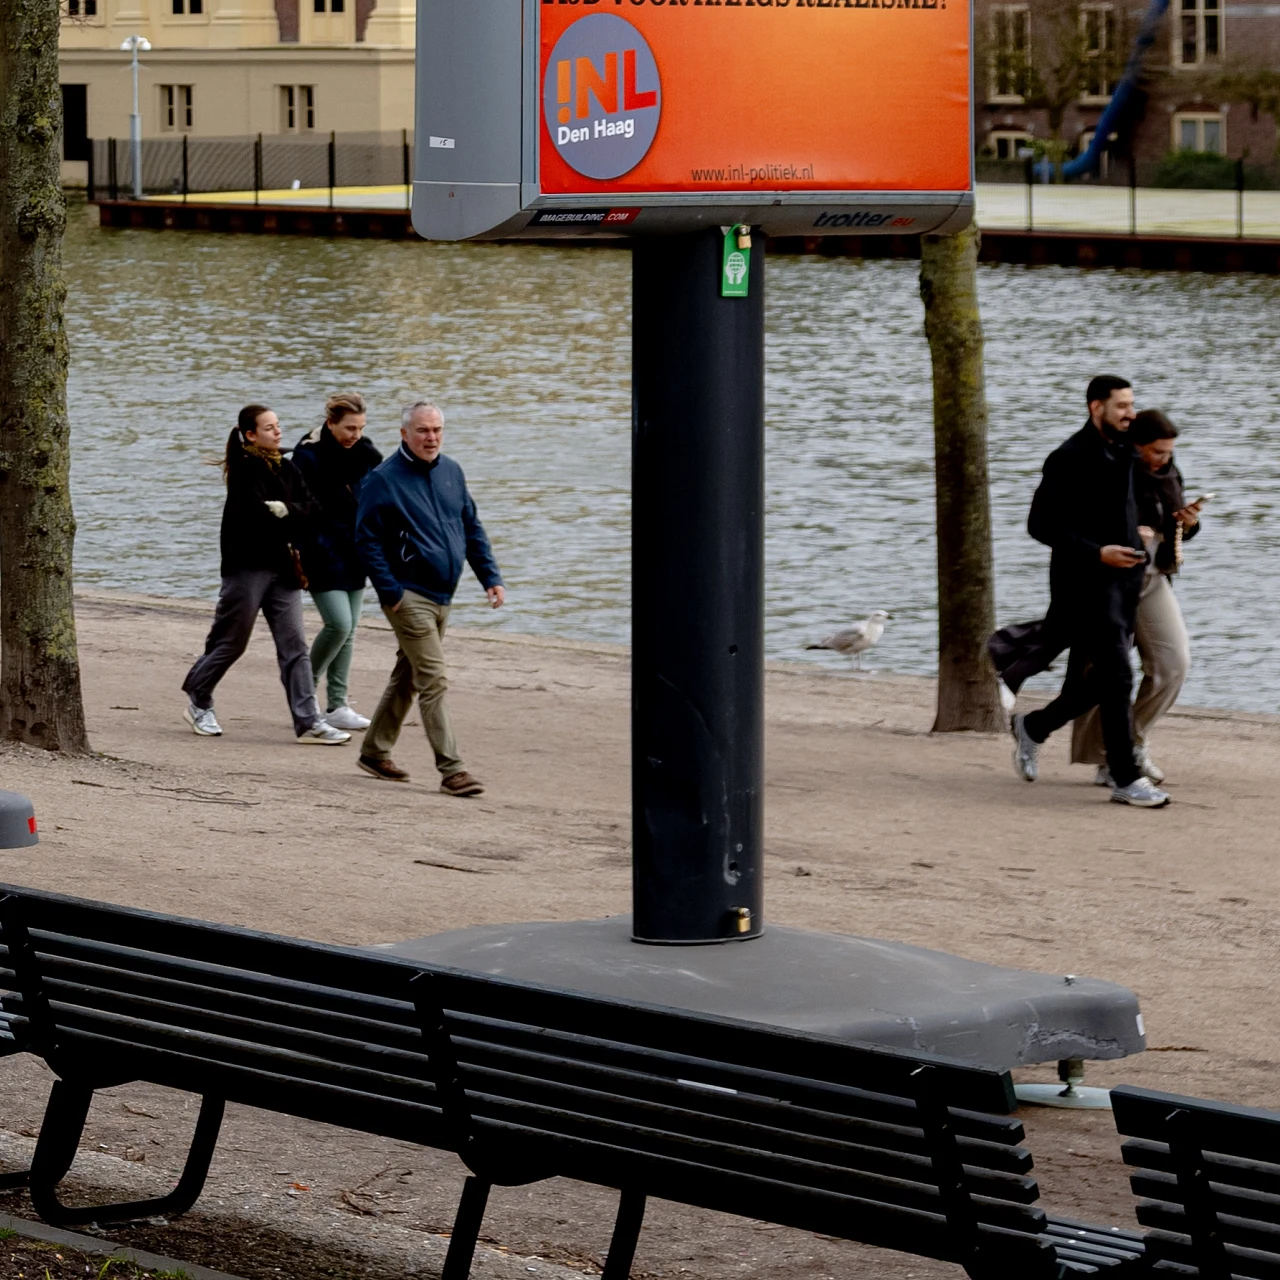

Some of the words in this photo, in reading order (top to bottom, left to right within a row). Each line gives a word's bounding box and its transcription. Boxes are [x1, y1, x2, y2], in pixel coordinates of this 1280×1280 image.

[558, 126, 589, 145] Den
[594, 119, 635, 138] Haag
[692, 164, 814, 184] www.inl-politiek.nl
[812, 211, 894, 227] trotter
